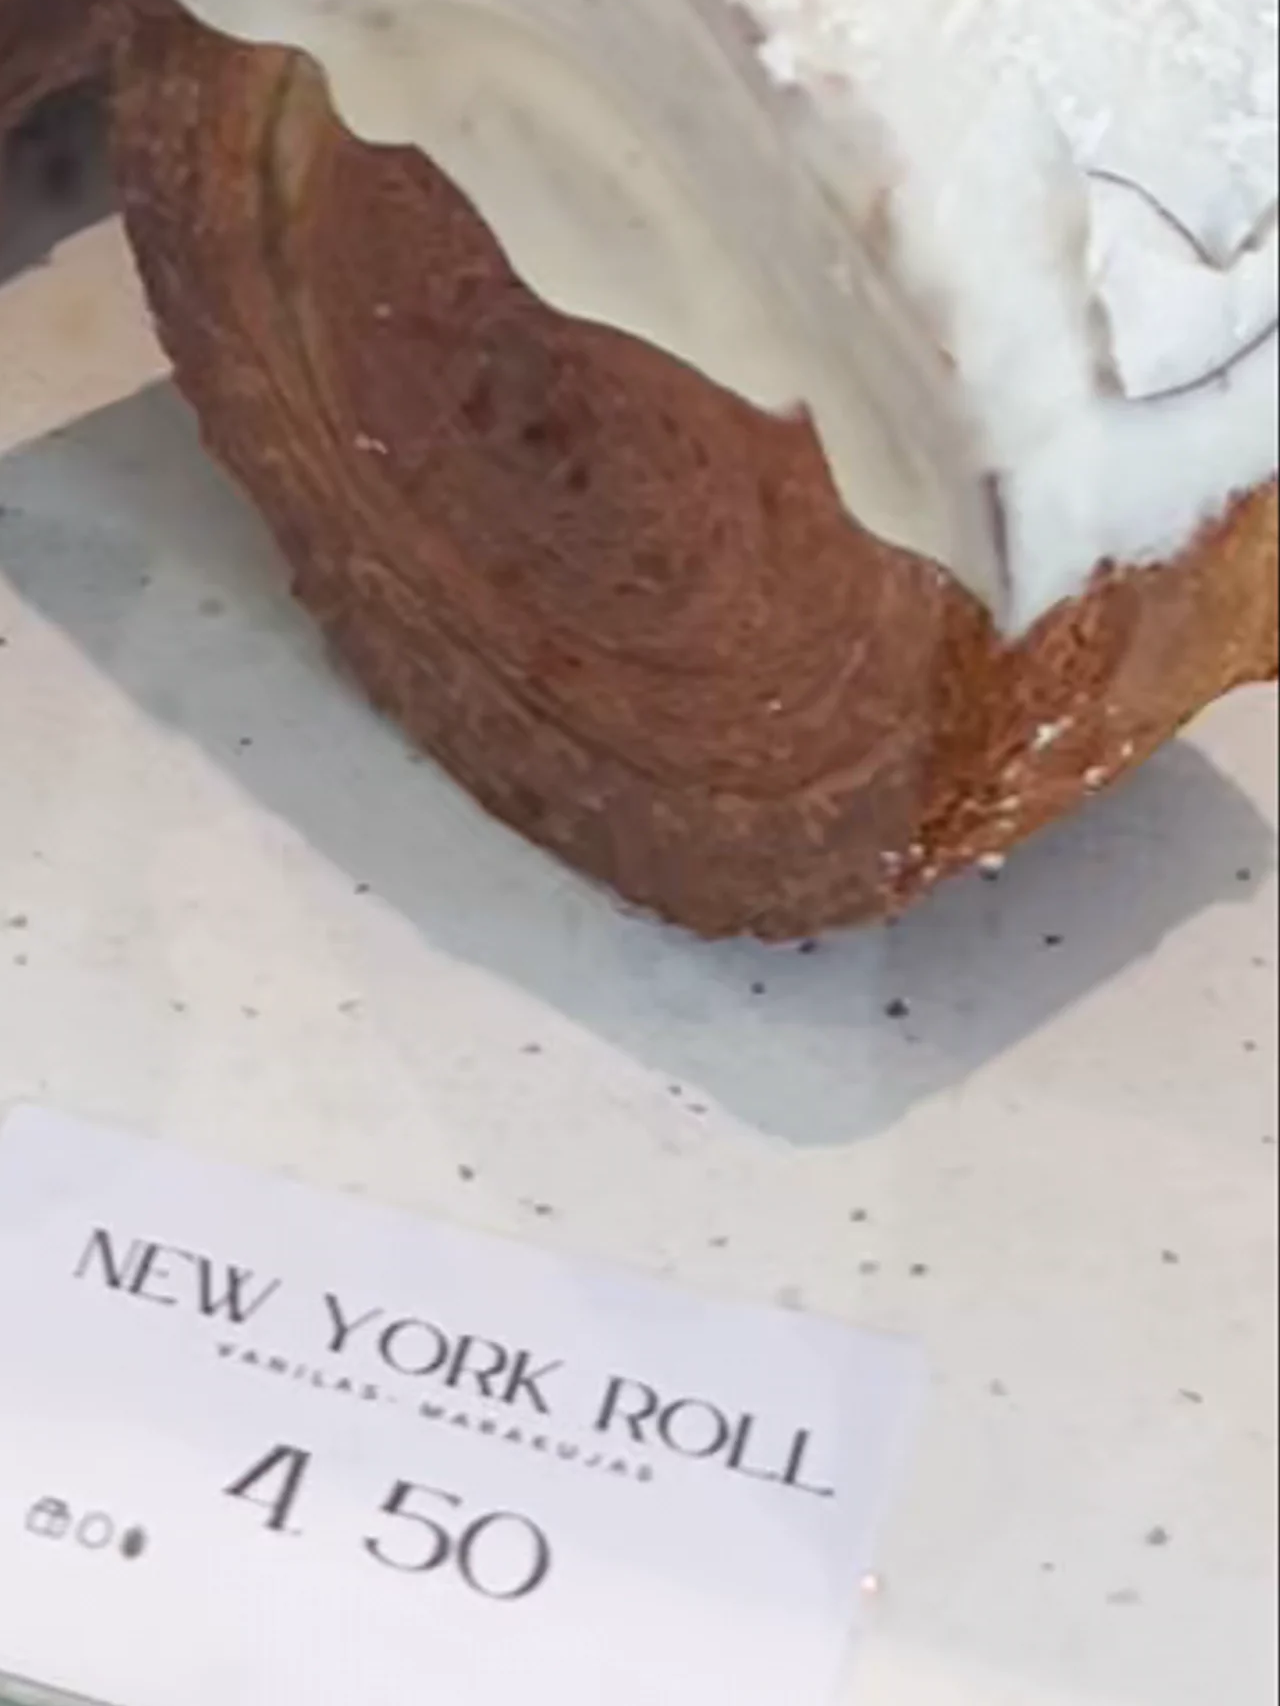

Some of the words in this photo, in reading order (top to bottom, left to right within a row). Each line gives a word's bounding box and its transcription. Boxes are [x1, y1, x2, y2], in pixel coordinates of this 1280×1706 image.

[72, 1227, 282, 1325] NEW
[323, 1291, 564, 1416] YORK
[593, 1374, 836, 1499] ROLL
[418, 1401, 653, 1483] MARAKUJAS
